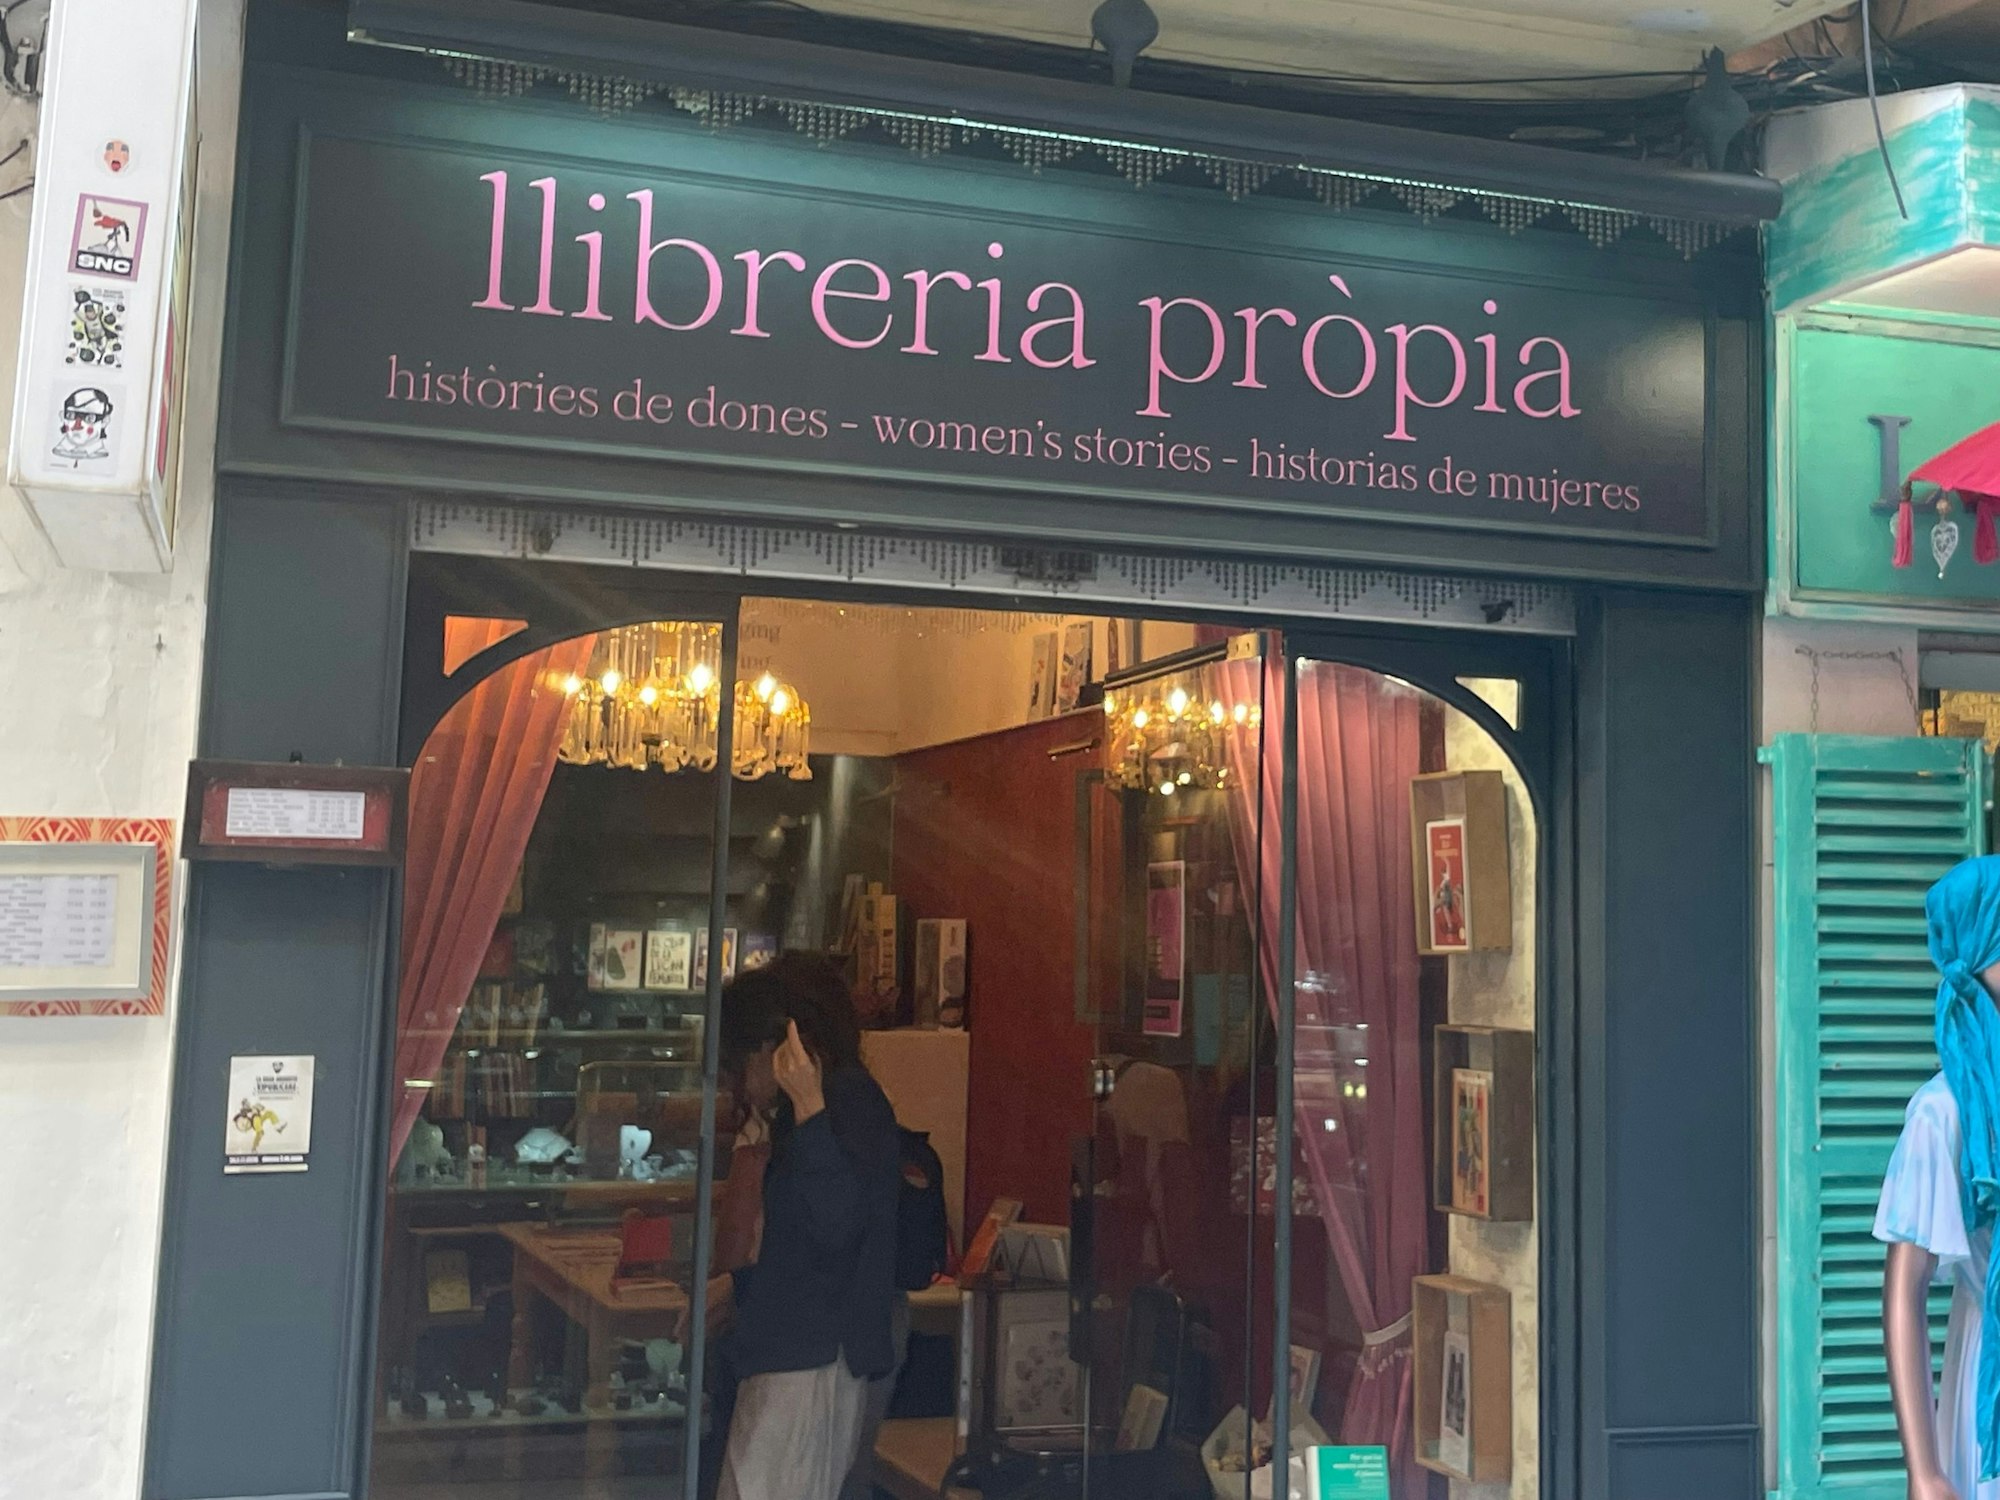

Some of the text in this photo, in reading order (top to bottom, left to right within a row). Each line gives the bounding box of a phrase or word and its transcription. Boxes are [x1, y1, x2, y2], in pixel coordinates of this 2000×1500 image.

[77, 253, 131, 274] SNC
[472, 170, 1582, 442] llibreria pròpia
[387, 354, 599, 419] històries
[613, 379, 673, 424] de
[688, 386, 827, 438] dones
[872, 414, 1062, 462] women's
[1073, 425, 1212, 474] stories
[1250, 438, 1417, 490] historias
[1428, 457, 1477, 497] de
[1488, 469, 1641, 514] mujeres
